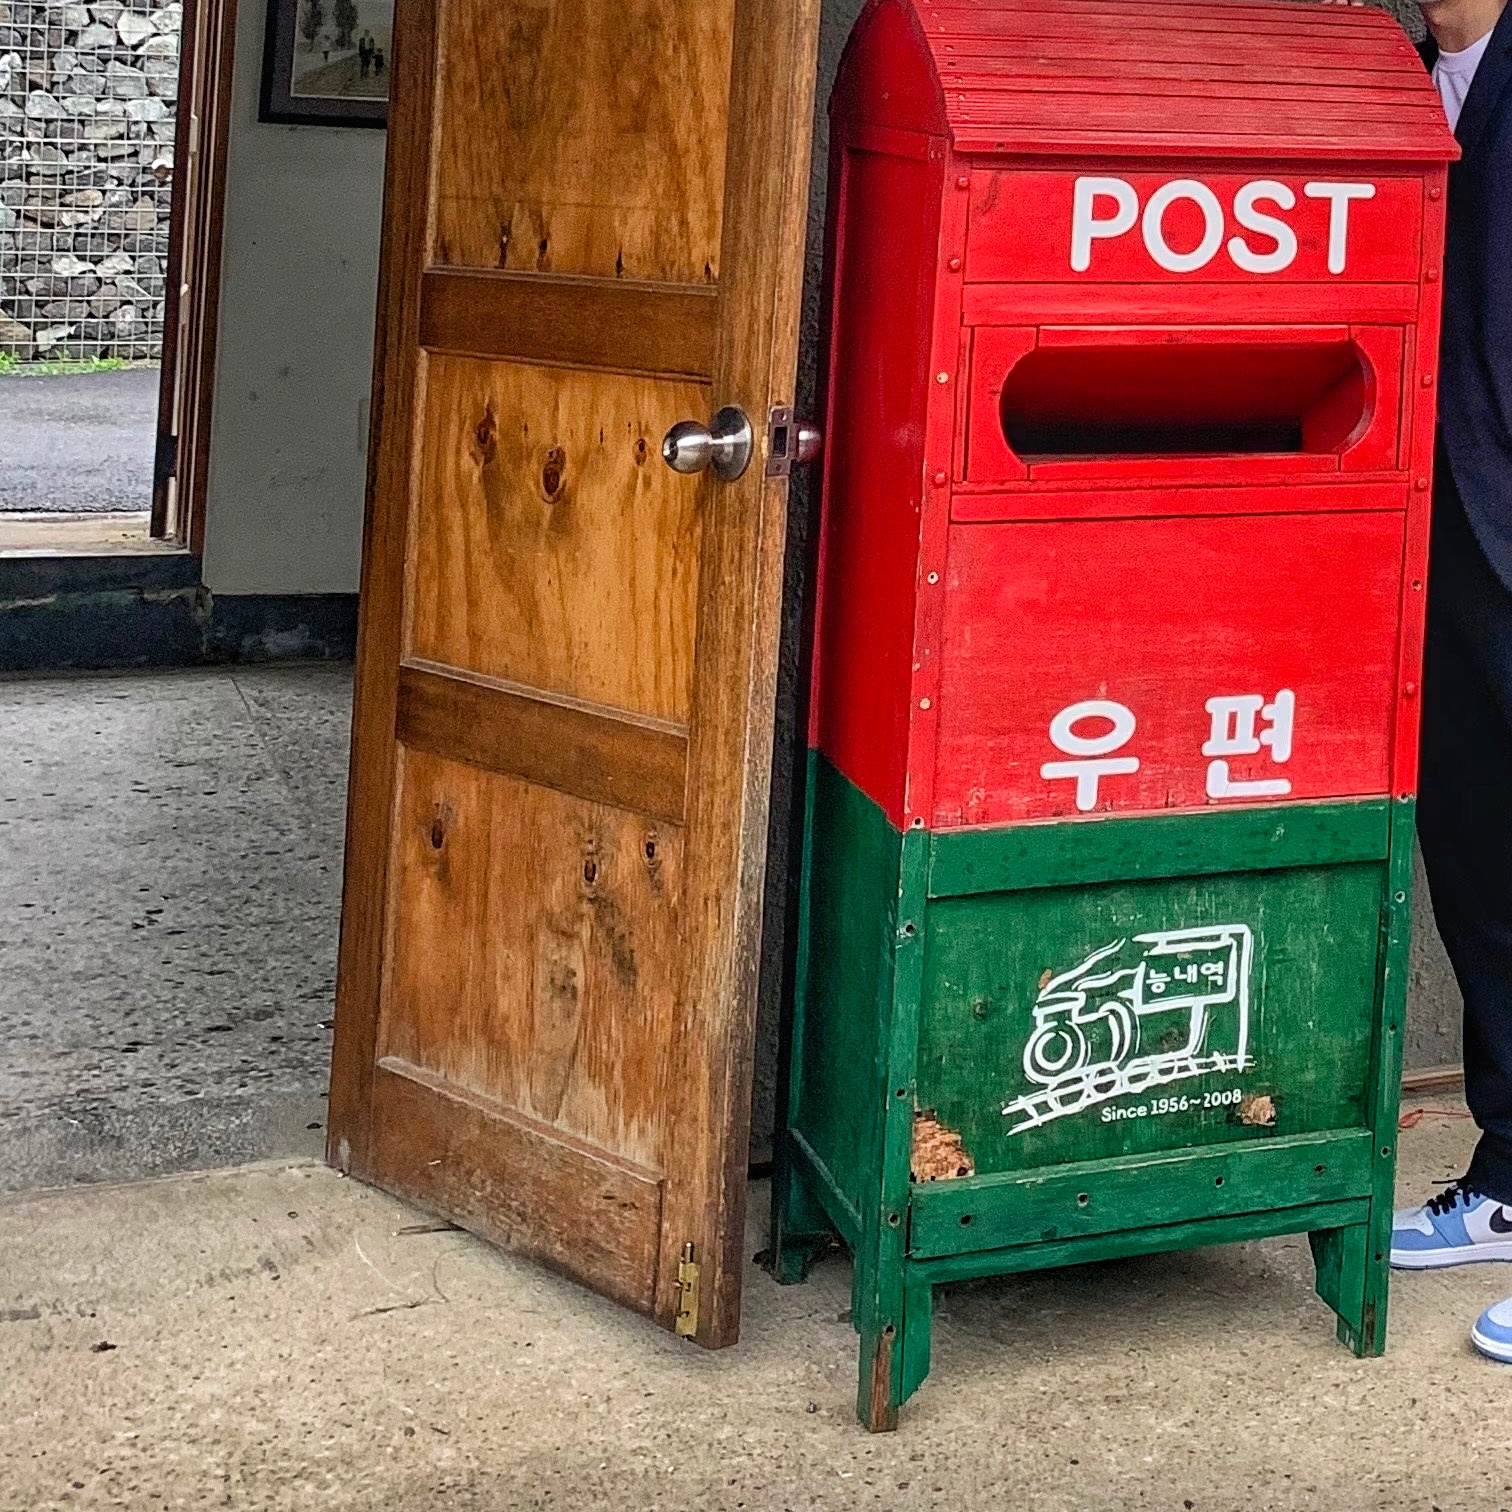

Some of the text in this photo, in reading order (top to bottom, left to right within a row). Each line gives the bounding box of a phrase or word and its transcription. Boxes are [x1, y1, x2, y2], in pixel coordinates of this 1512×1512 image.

[1072, 177, 1375, 274] POST
[1146, 961, 1224, 994] 능내역
[1101, 1089, 1242, 1122] Since 1956~2008
